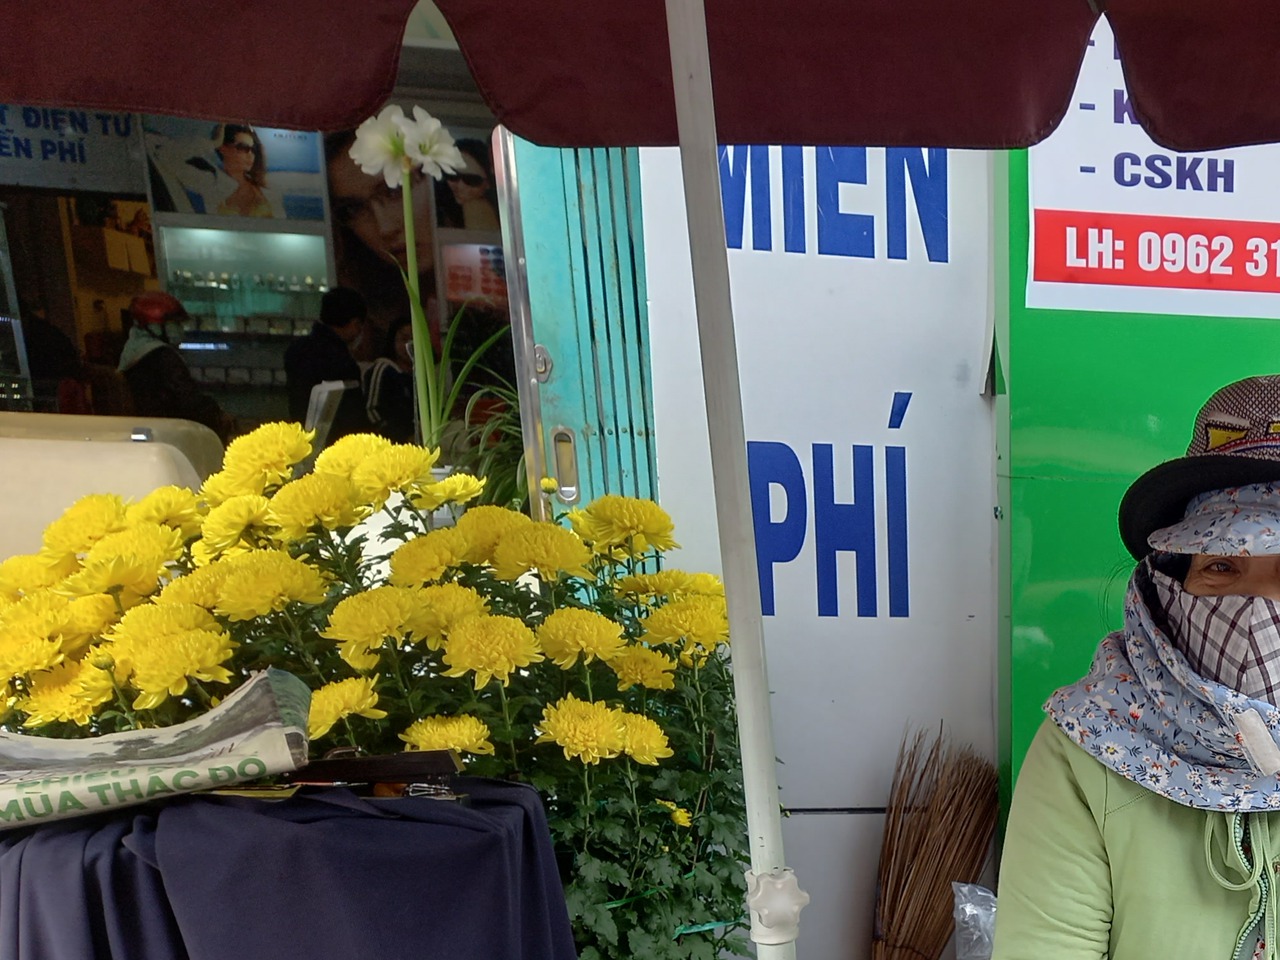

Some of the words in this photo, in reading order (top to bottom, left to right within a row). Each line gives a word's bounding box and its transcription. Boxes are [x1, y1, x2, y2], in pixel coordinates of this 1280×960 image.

[41, 136, 87, 164] PHÍ
[1113, 152, 1235, 193] CSKH
[1066, 226, 1124, 270] LH:
[1138, 231, 1233, 275] 0962
[747, 392, 912, 619] PHÍ
